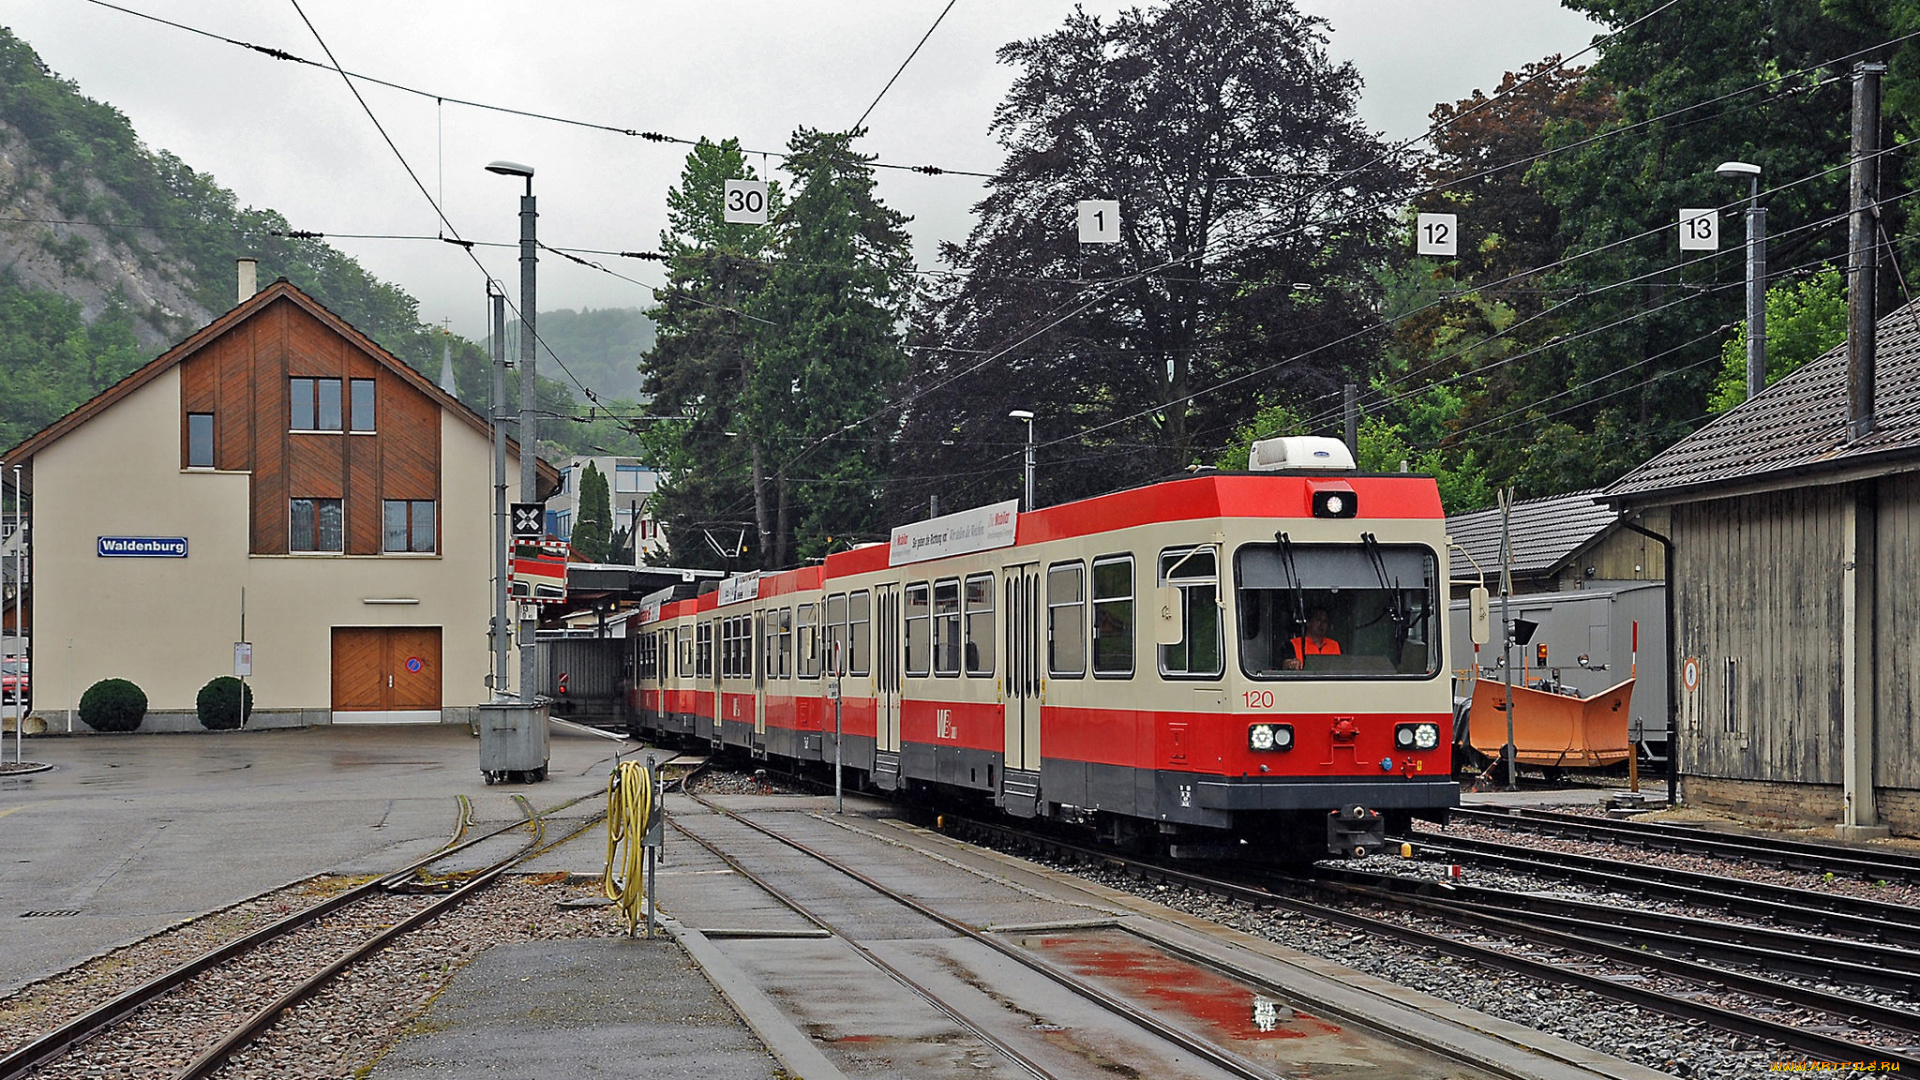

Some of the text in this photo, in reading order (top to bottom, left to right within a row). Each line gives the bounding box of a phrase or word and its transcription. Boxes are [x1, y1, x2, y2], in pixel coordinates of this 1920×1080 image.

[728, 190, 763, 213] 30
[1093, 210, 1103, 232] 1
[1686, 218, 1712, 239] 13
[1423, 223, 1449, 244] 12
[102, 540, 184, 553] Waldenburg
[1242, 690, 1274, 708] 120
